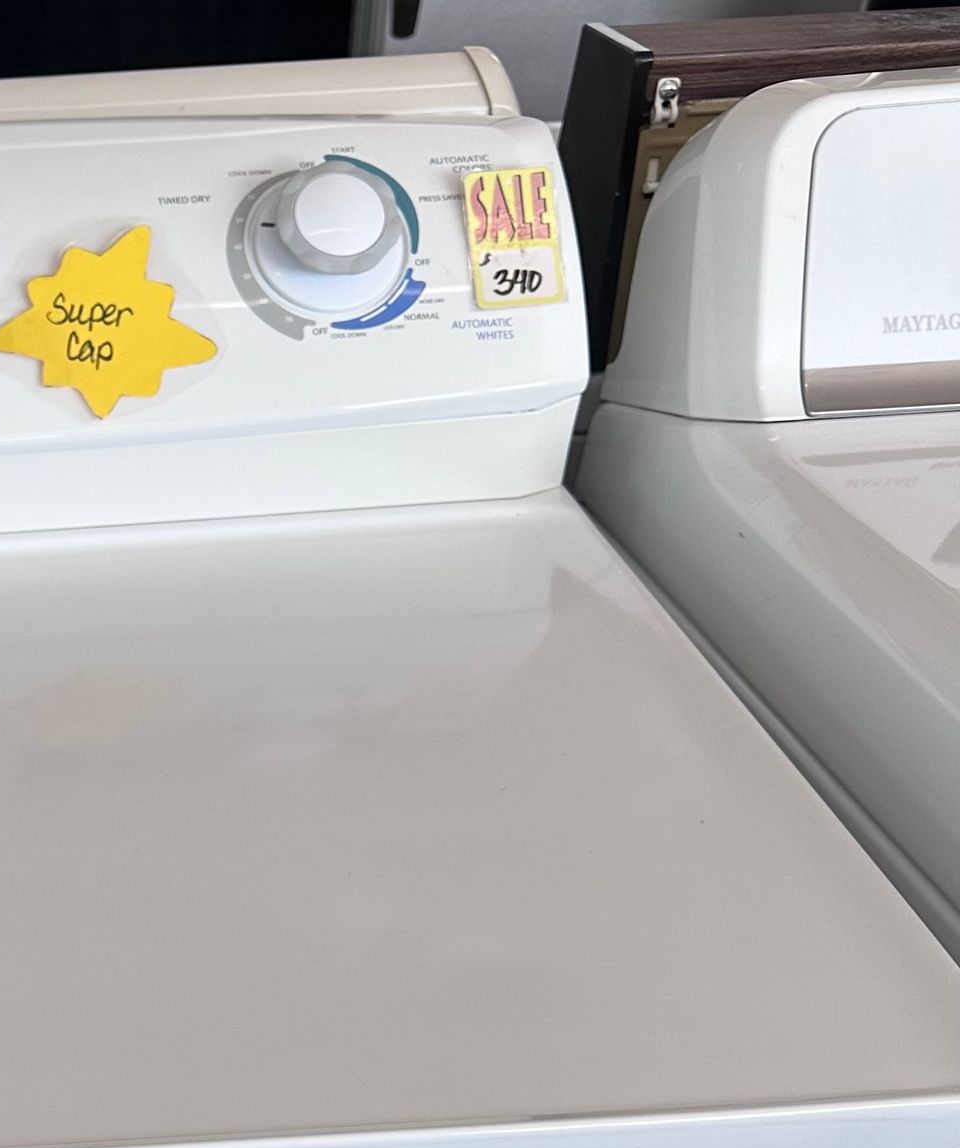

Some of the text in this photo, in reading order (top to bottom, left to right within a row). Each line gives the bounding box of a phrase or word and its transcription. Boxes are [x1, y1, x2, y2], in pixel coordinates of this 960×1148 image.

[429, 154, 490, 166] AUTOMATIC
[158, 194, 211, 206] TIMED DRY
[470, 171, 552, 246] SALE
[414, 258, 431, 267] OFF
[493, 268, 543, 297] 340
[45, 292, 134, 332] Super
[403, 312, 440, 322] NORMAL
[451, 317, 513, 329] AUTOMATIC
[881, 312, 960, 334] MAYTAG
[312, 328, 329, 337] OFF
[476, 328, 514, 341] WHITES
[66, 330, 114, 371] Cap
